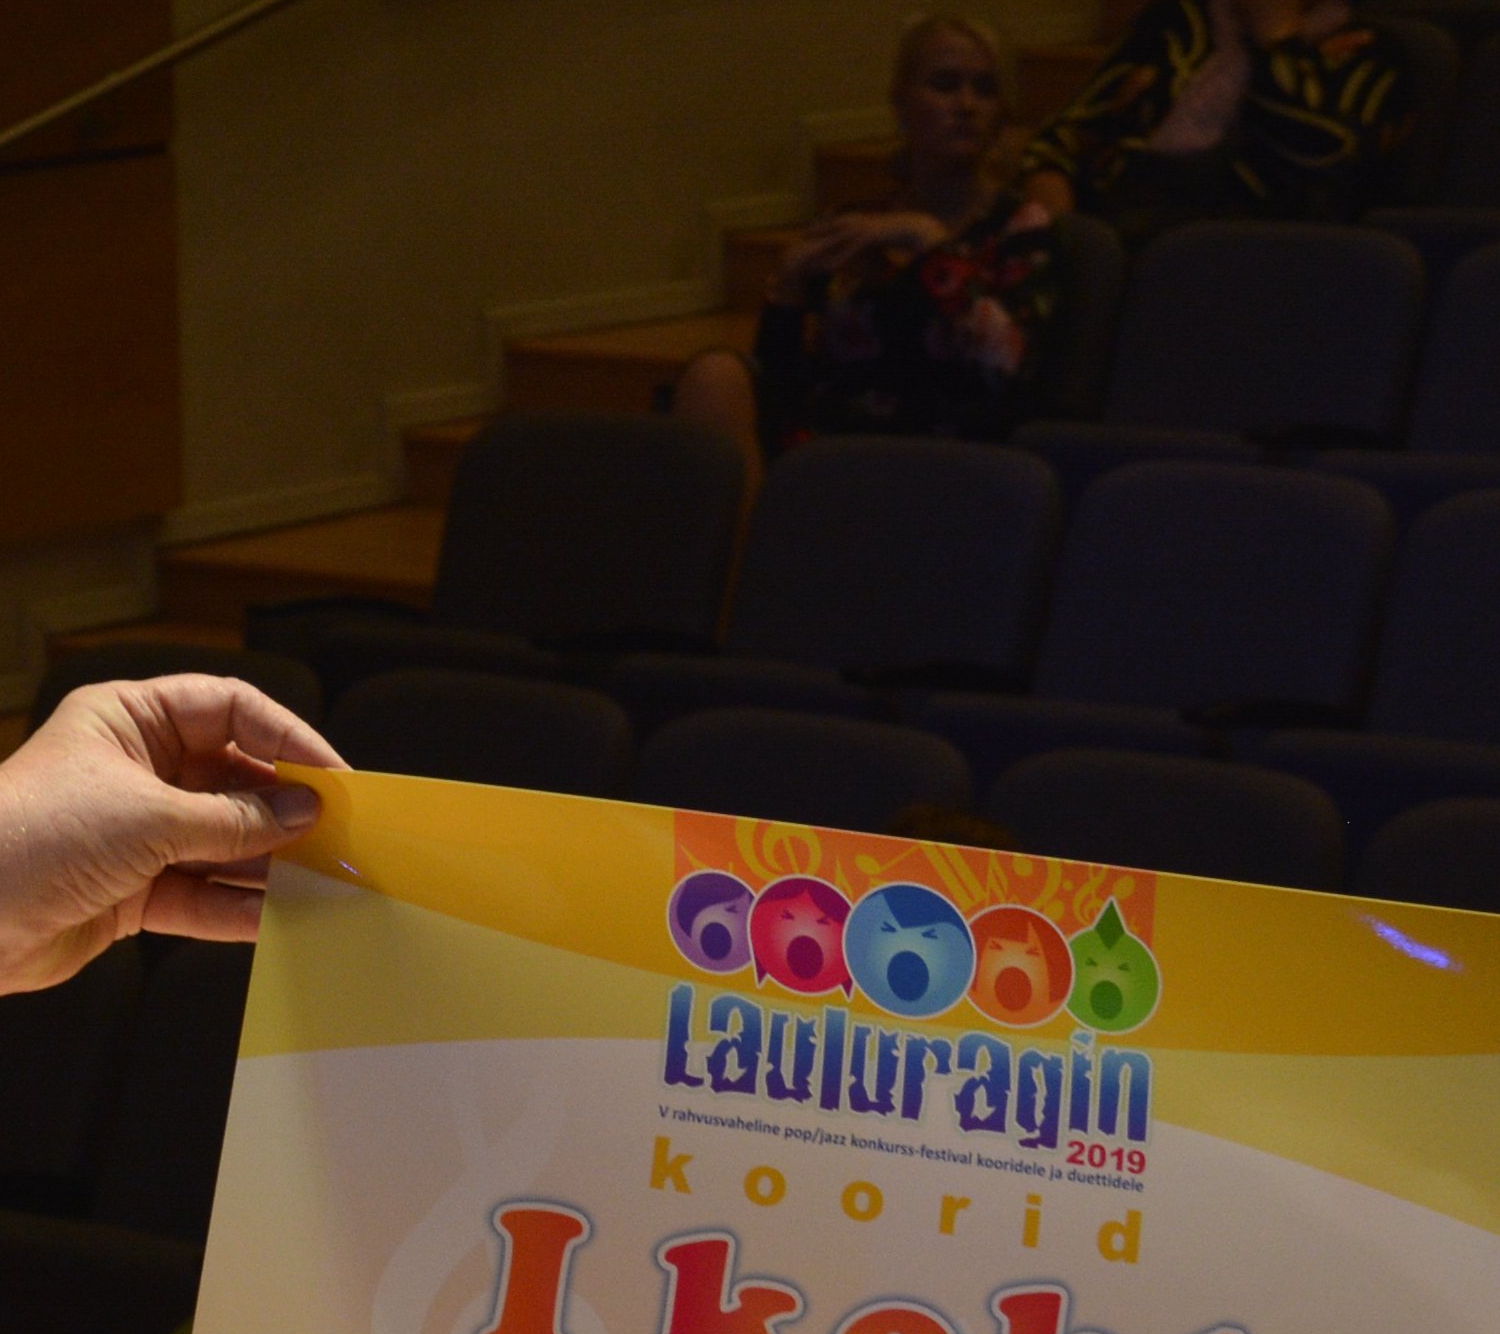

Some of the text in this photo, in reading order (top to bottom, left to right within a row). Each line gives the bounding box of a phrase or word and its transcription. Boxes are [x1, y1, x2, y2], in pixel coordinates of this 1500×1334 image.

[662, 983, 1153, 1151] Lauluragin
[649, 1136, 1143, 1264] koorid
[658, 1104, 1145, 1193] V rahvusvaheline pop/jazz konkurss-festival kooridele ja duettidele
[1066, 1140, 1146, 1175] 2019
